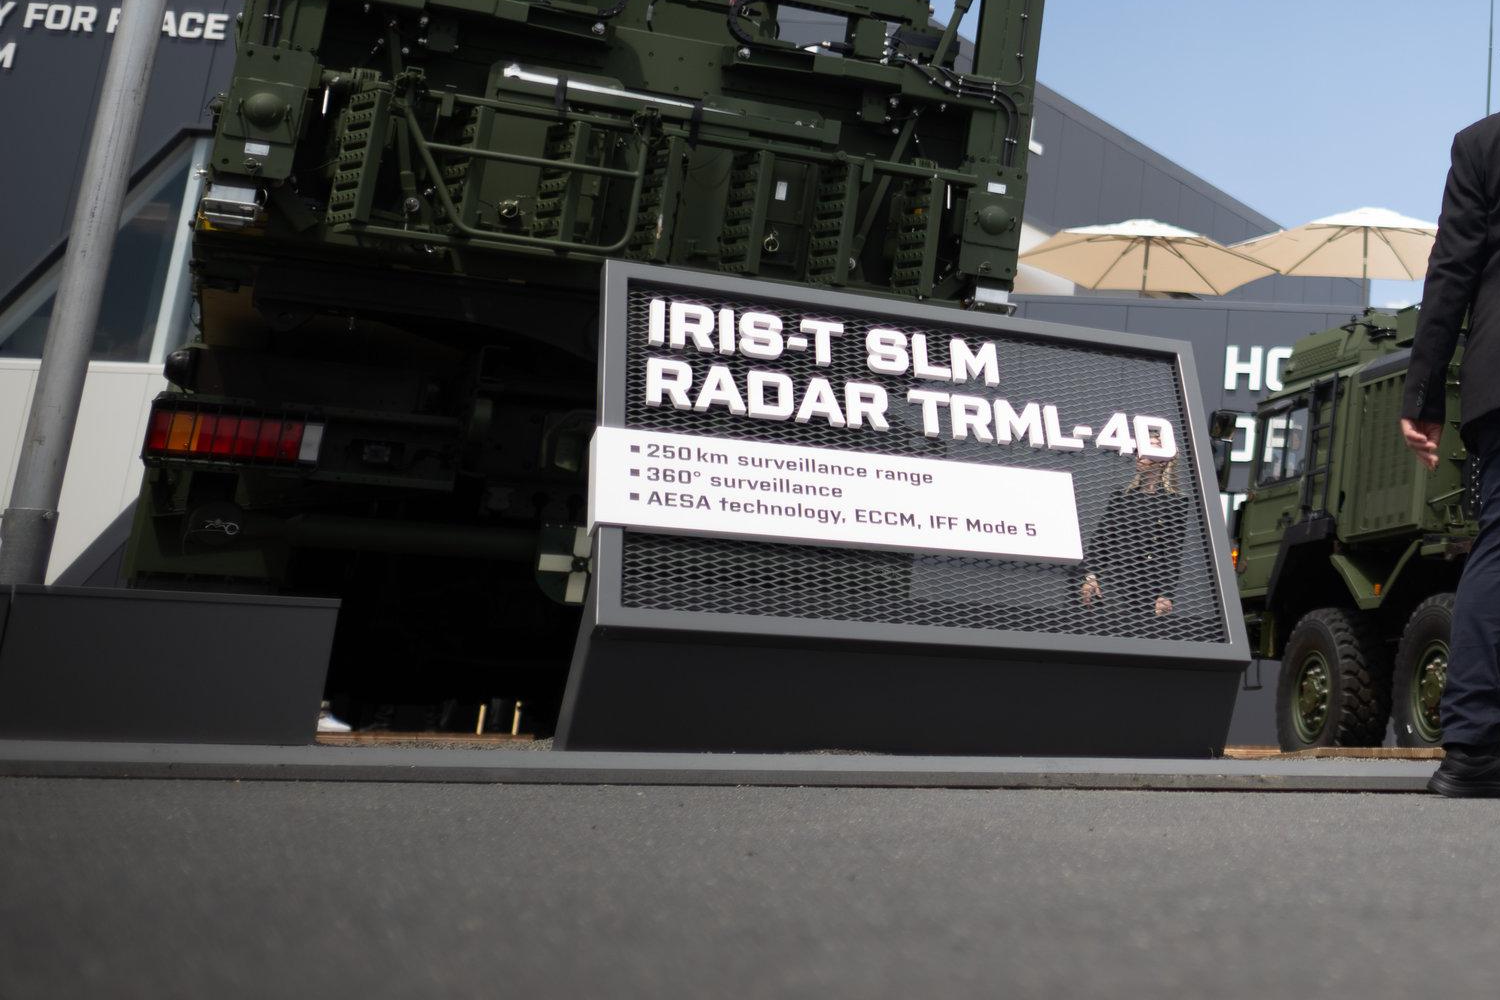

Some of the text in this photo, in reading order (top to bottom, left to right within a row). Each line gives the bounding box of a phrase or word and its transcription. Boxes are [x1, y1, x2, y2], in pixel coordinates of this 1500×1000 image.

[23, 2, 98, 33] FOR
[105, 7, 230, 41] PACE
[647, 298, 1000, 388] IRIS-T SLM
[645, 357, 1179, 459] RADAR TRML-4D
[646, 443, 933, 486] 250 km surveillance range
[646, 467, 843, 497] 360° surveillance
[646, 490, 1037, 537] AESA technology, ECCM, IFF Mode 5
